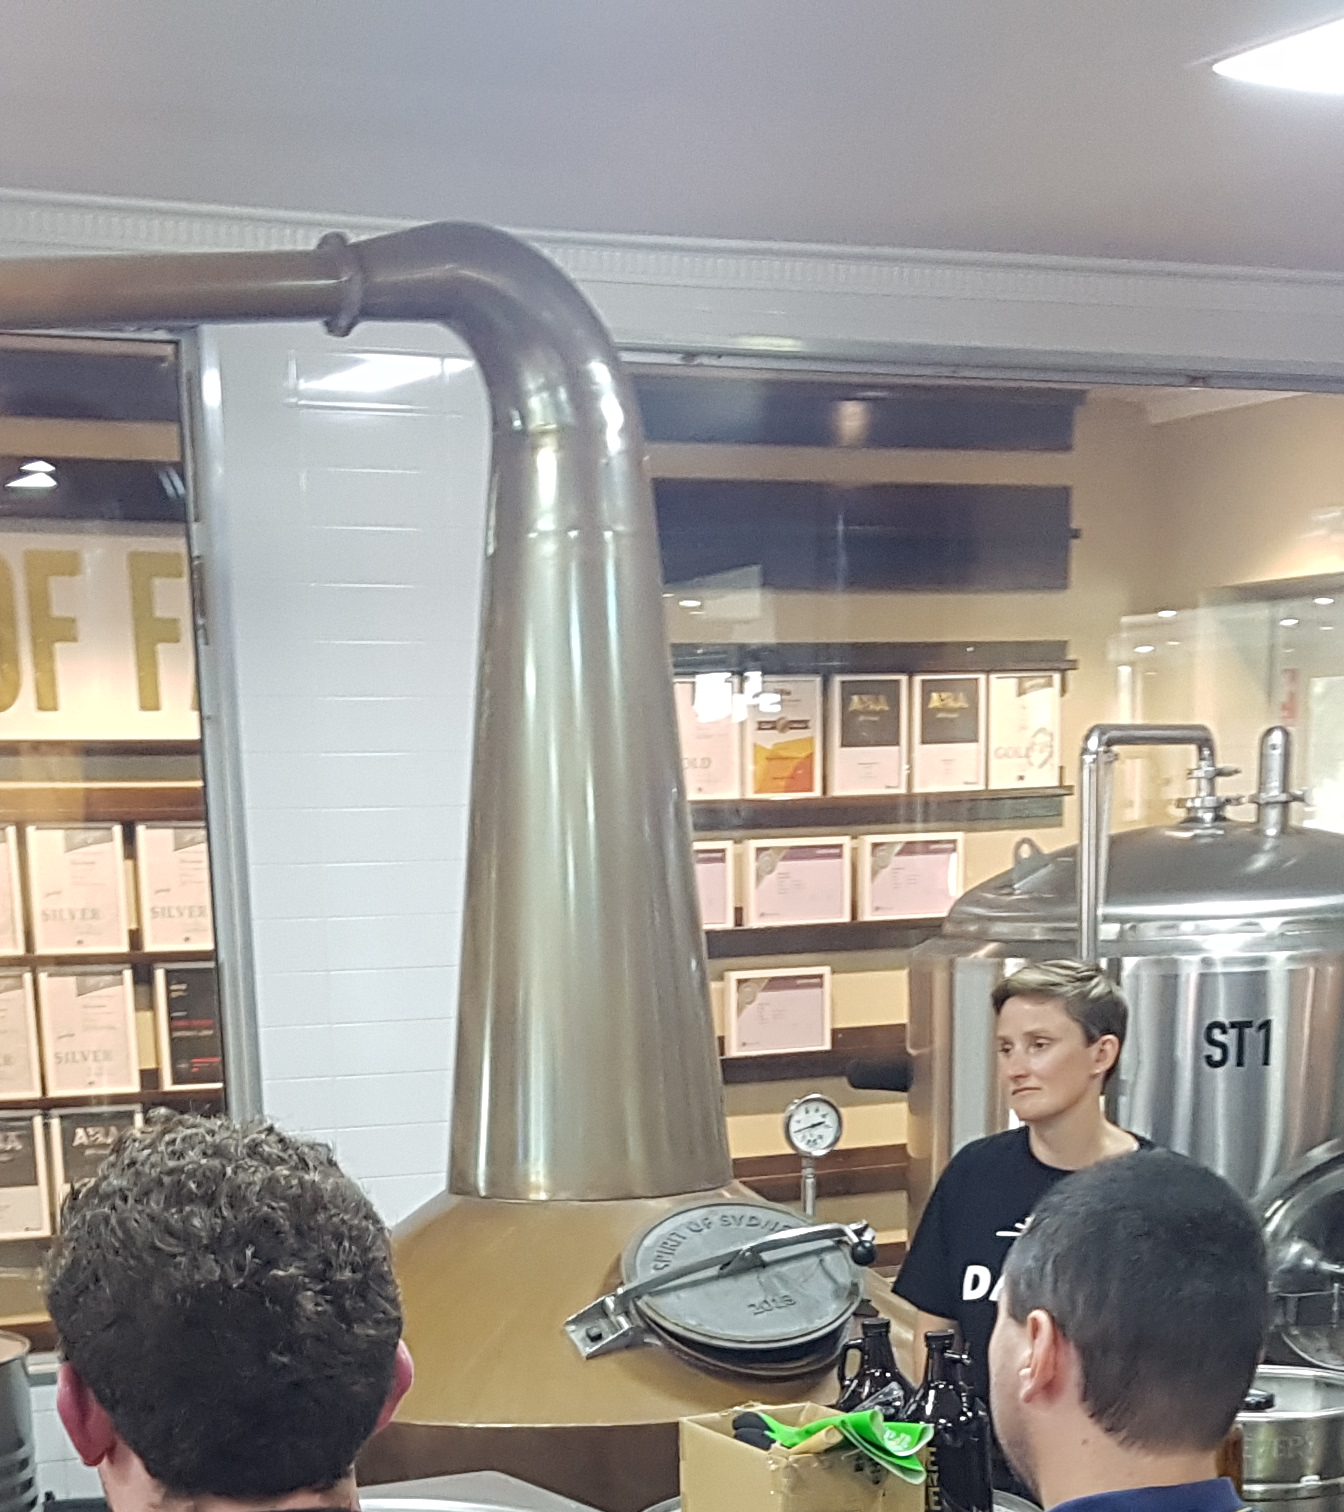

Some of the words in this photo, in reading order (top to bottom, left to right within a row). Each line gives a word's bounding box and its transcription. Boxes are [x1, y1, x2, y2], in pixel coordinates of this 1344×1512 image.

[126, 550, 200, 712] F
[41, 906, 103, 922] SILVER
[1204, 1019, 1271, 1069] ST1
[686, 1216, 714, 1234] OF
